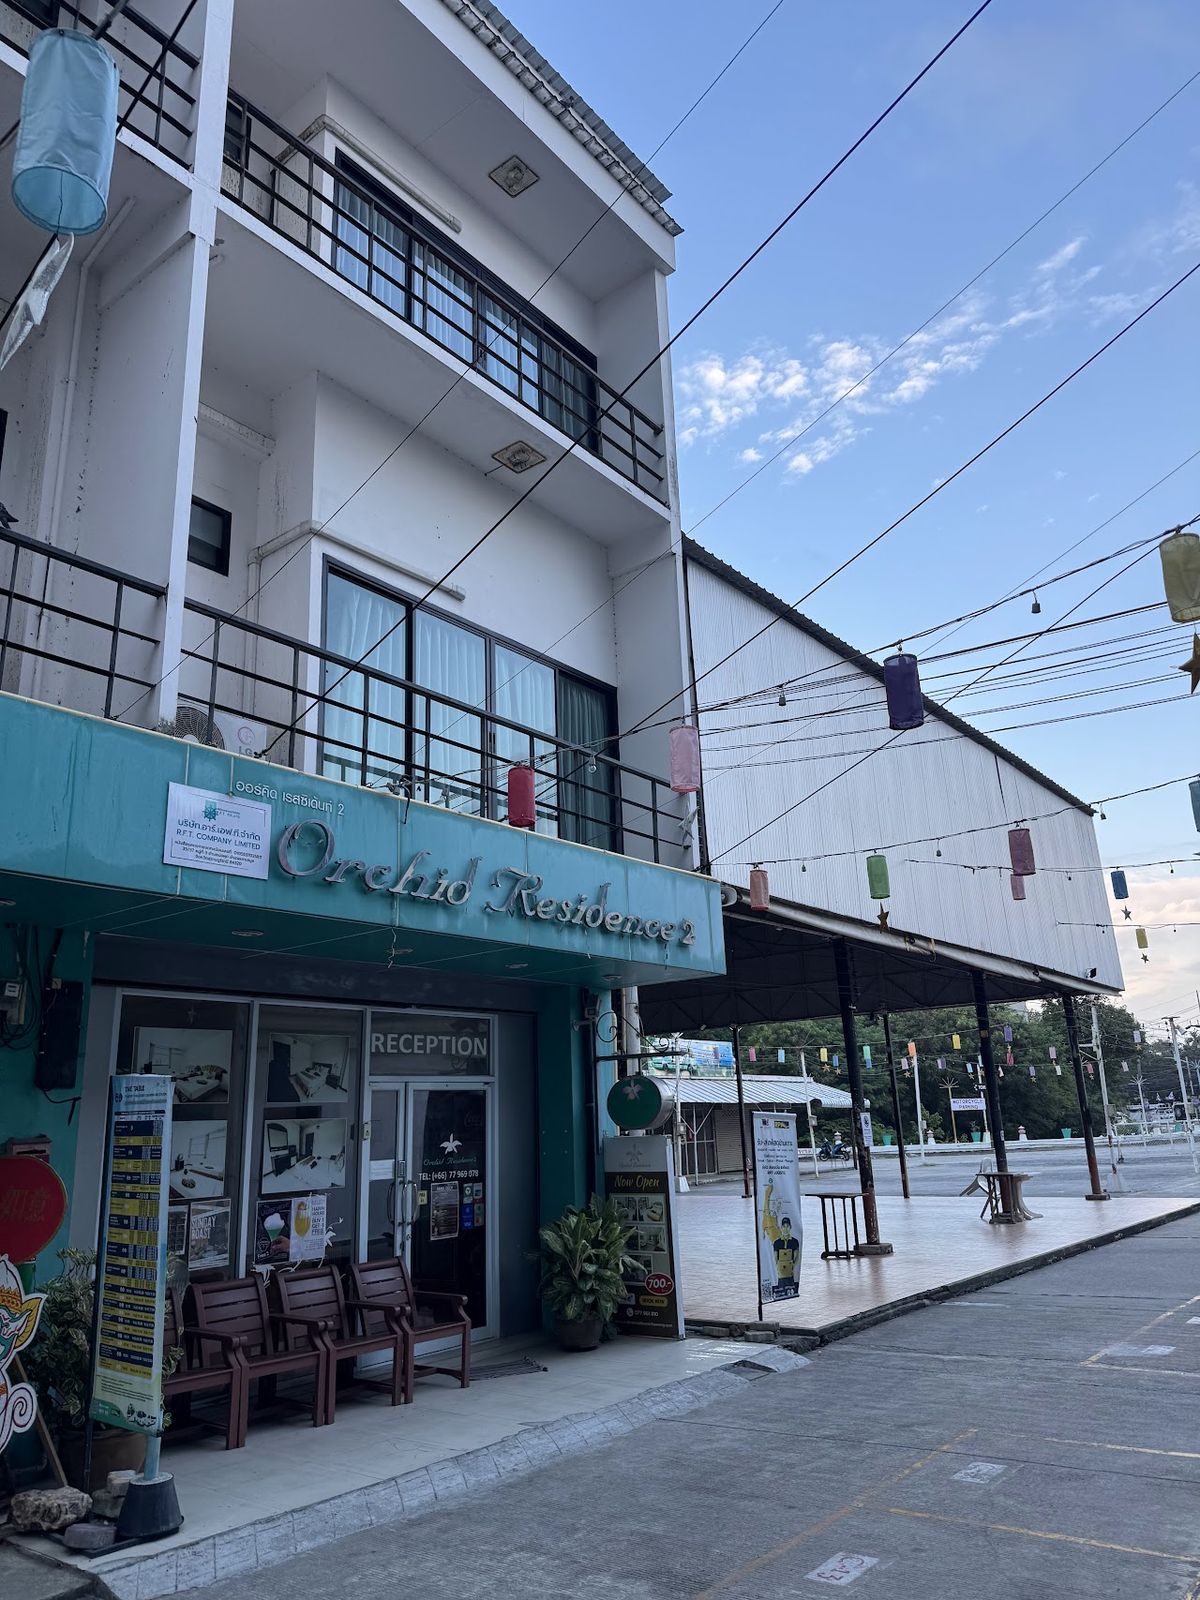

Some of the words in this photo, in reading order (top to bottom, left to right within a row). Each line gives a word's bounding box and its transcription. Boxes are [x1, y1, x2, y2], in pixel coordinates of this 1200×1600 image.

[239, 746, 253, 756] LG
[337, 803, 345, 816] 2
[196, 832, 232, 846] COMPANY
[234, 839, 261, 850] LIMITED
[277, 818, 483, 908] Orchid
[484, 866, 678, 943] Residence
[680, 917, 697, 946] 2
[371, 1032, 487, 1056] RECEPTION
[419, 1172, 431, 1181] TEL:
[449, 1171, 457, 1179] 77
[614, 1175, 633, 1188] Now
[635, 1175, 660, 1192] Open
[191, 1227, 211, 1240] ROAST
